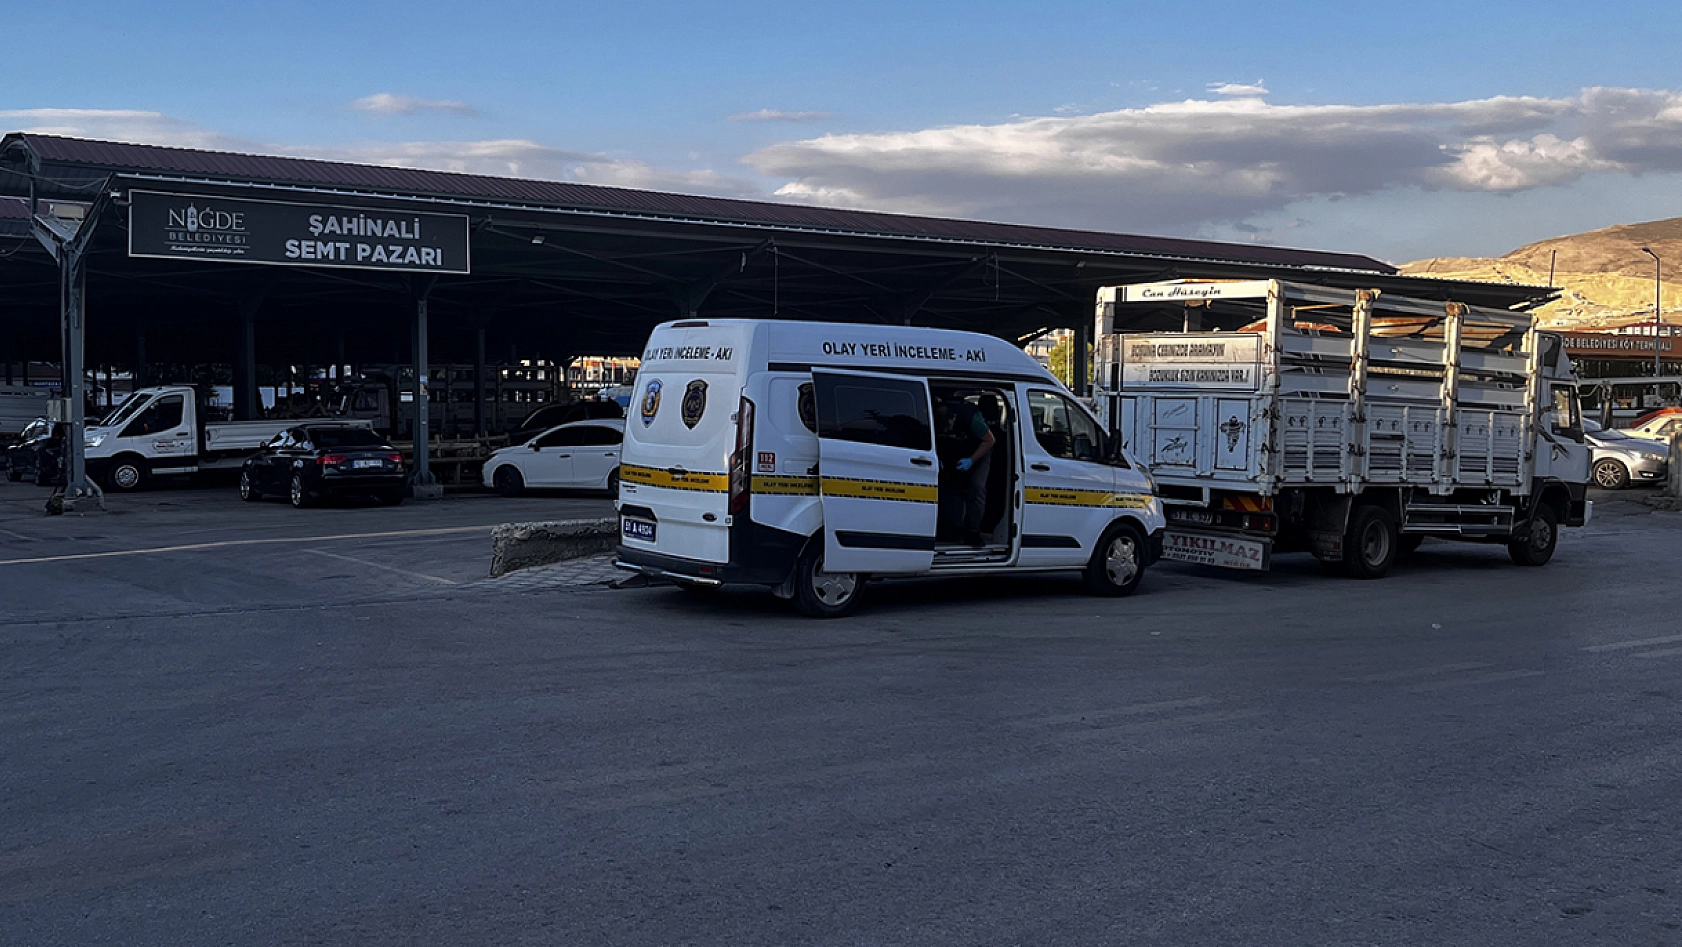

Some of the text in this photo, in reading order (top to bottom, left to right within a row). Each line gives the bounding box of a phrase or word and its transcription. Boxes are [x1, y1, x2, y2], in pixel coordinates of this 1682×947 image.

[308, 213, 420, 240] ŞAHİNALİ
[285, 240, 442, 266] SEMT PAZARI
[1142, 289, 1164, 298] Can
[822, 341, 857, 356] OLAY
[861, 341, 891, 357] YERİ
[894, 342, 957, 361] İNCELEME
[966, 347, 986, 363] AKİ
[760, 453, 773, 463] 112
[1170, 535, 1260, 562] YIKILMAZ
